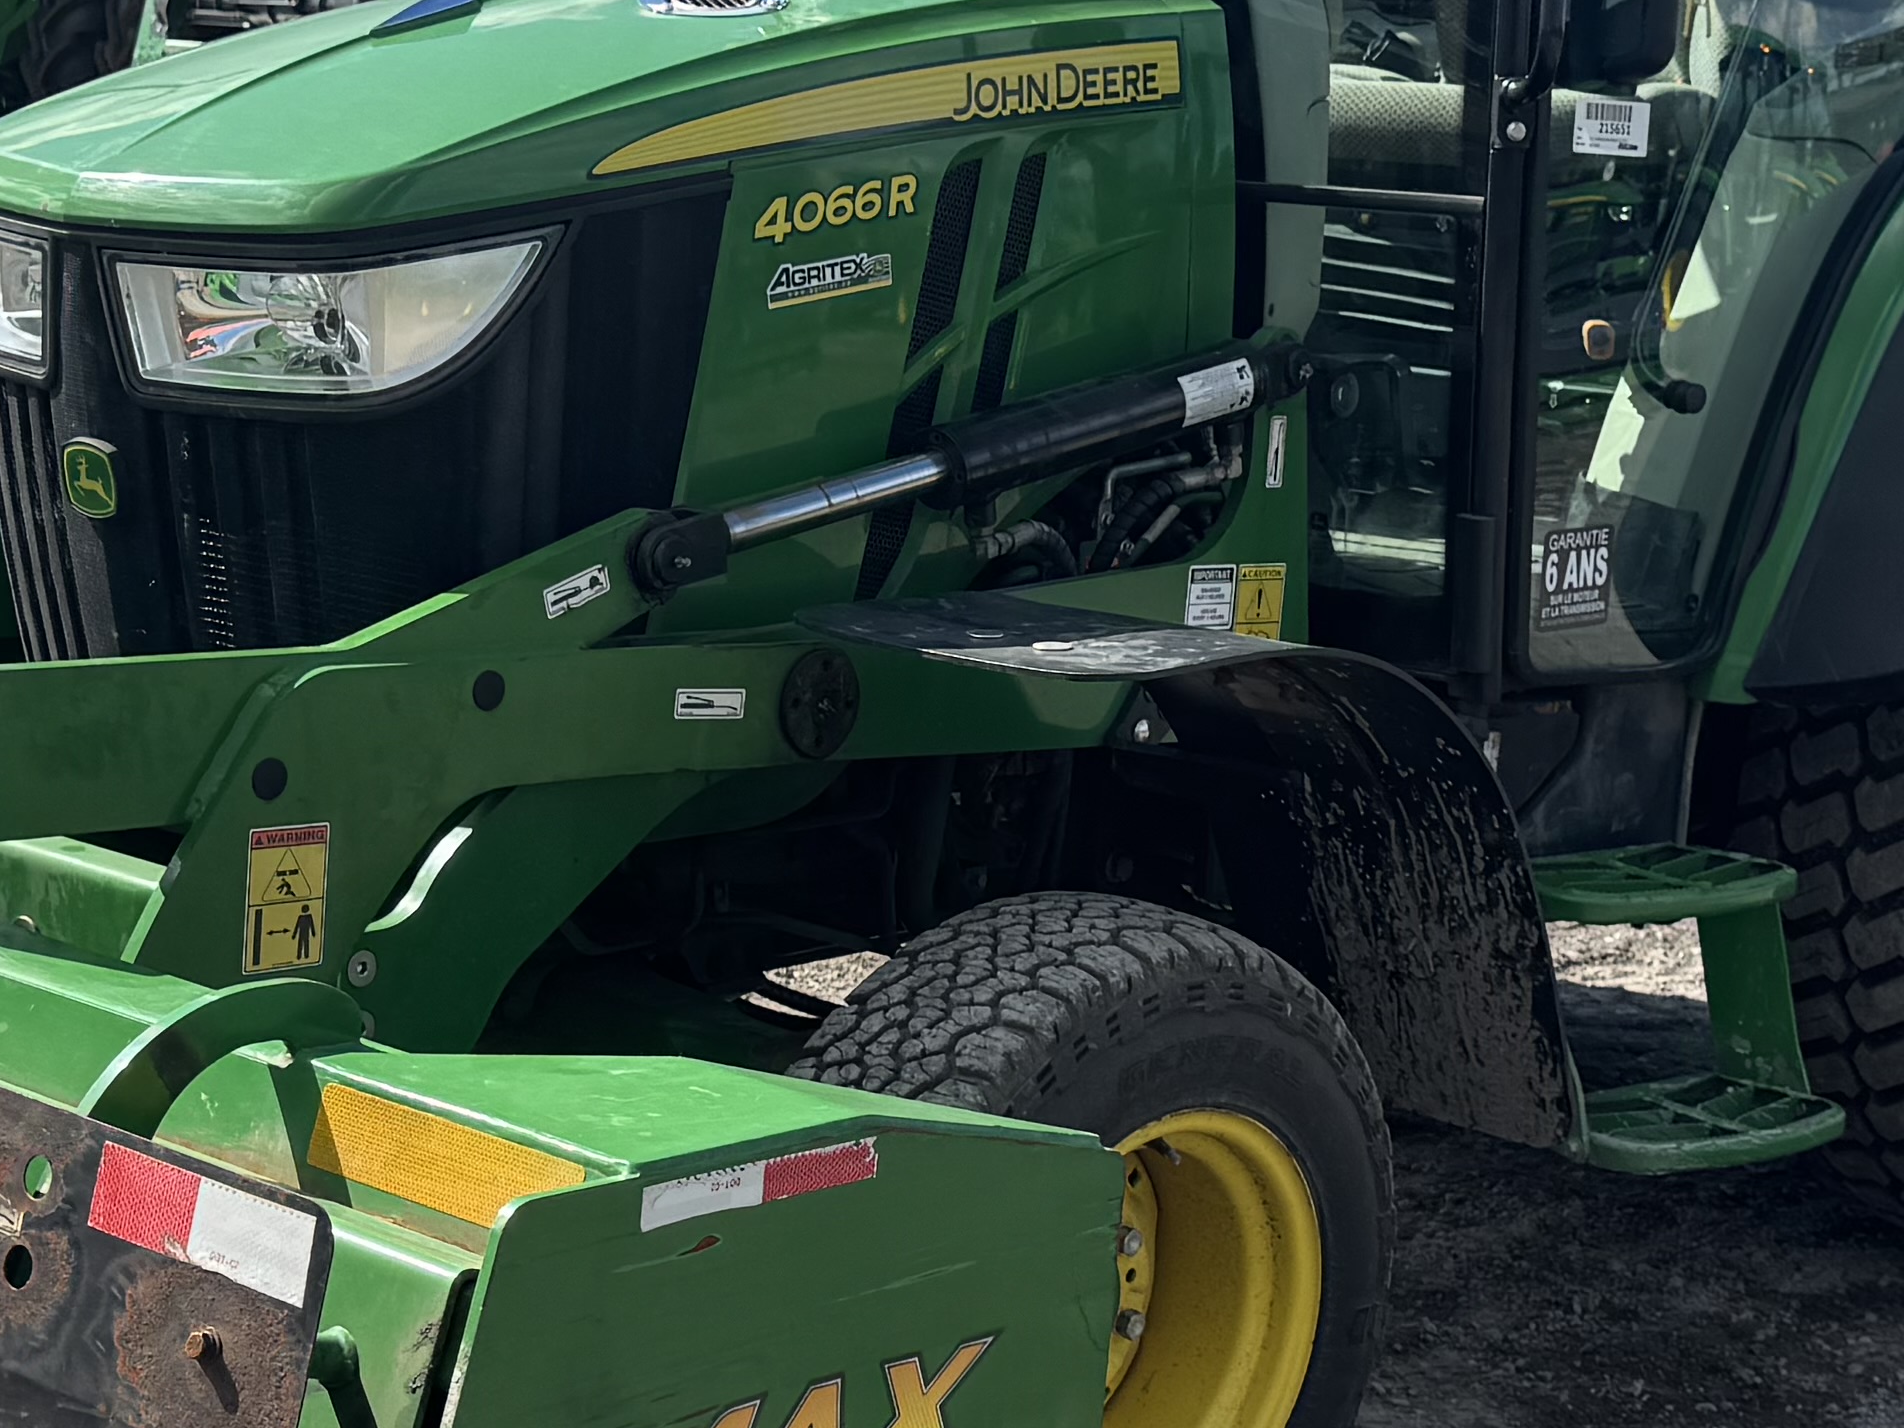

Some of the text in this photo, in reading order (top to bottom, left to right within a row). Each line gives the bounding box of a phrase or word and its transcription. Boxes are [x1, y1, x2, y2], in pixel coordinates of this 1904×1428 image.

[953, 62, 1159, 117] JOHN DEERE
[769, 256, 866, 292] AGRITEX
[1549, 528, 1609, 551] GARANTIE
[1248, 569, 1282, 578] CAUTION
[1545, 546, 1609, 592] 6 ANS
[266, 829, 325, 845] WARNING
